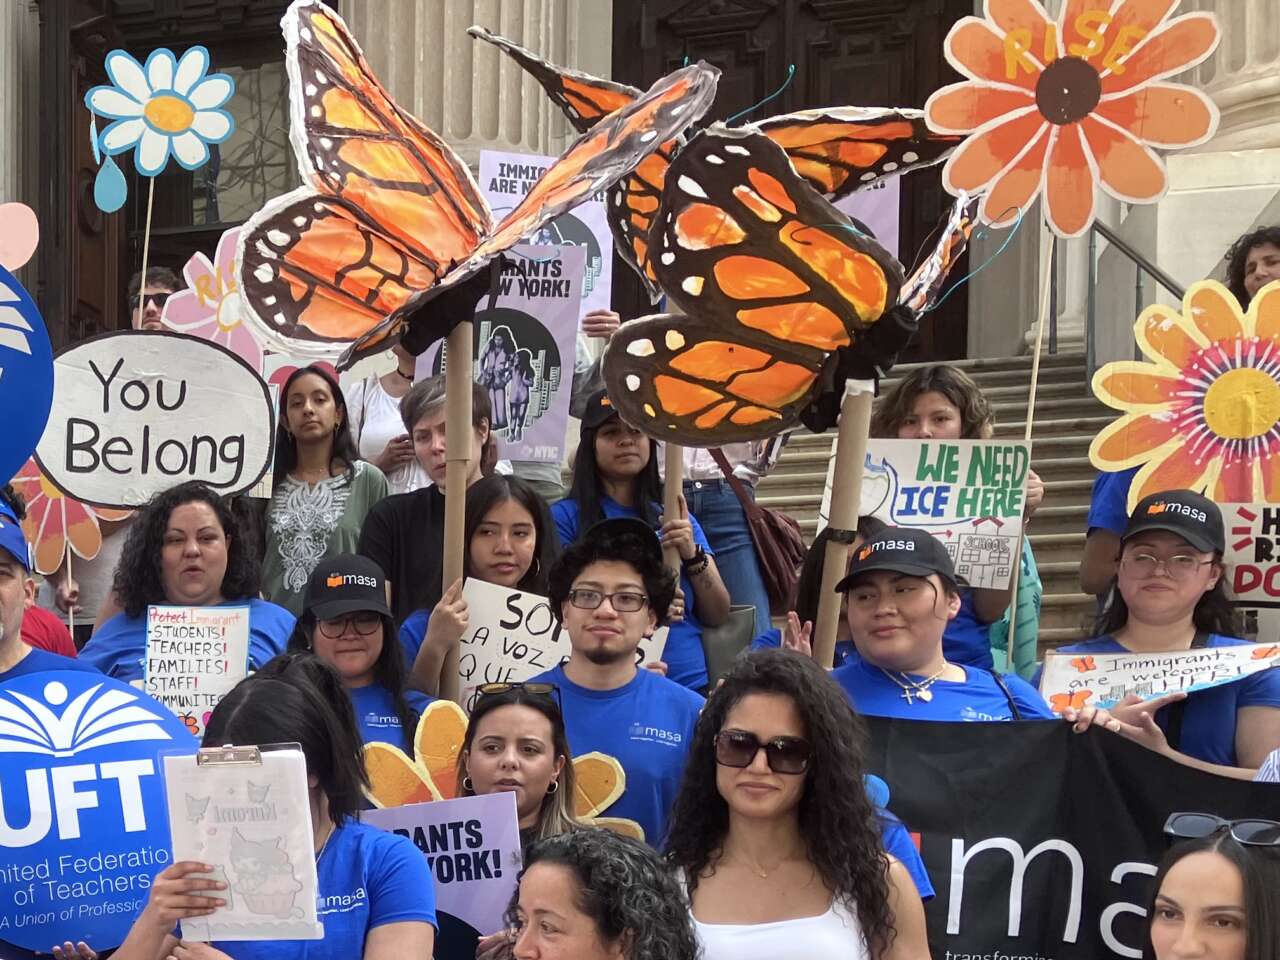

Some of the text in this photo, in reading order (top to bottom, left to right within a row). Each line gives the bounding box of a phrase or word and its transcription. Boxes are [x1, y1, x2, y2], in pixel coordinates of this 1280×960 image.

[1001, 10, 1147, 80] RISE
[88, 357, 188, 414] You
[65, 417, 246, 489] Belong
[915, 444, 1030, 490] WE NEED
[896, 485, 1024, 519] ICE HERE
[1165, 500, 1208, 523] masa
[872, 539, 915, 552] masa
[343, 574, 377, 588] masa
[154, 625, 226, 640] STUDENTS!
[150, 639, 227, 656] TEACHERS!
[503, 637, 545, 668] VOZ
[149, 658, 228, 675] FAMILIES!
[149, 677, 198, 692] STAFF!
[1069, 675, 1109, 689] are
[645, 727, 682, 742] masa
[58, 848, 170, 877] Federatio
[14, 871, 151, 906] of Teachers
[946, 836, 1158, 960] ma
[0, 916, 10, 930] A
[15, 909, 56, 928] Union
[60, 906, 74, 921] of
